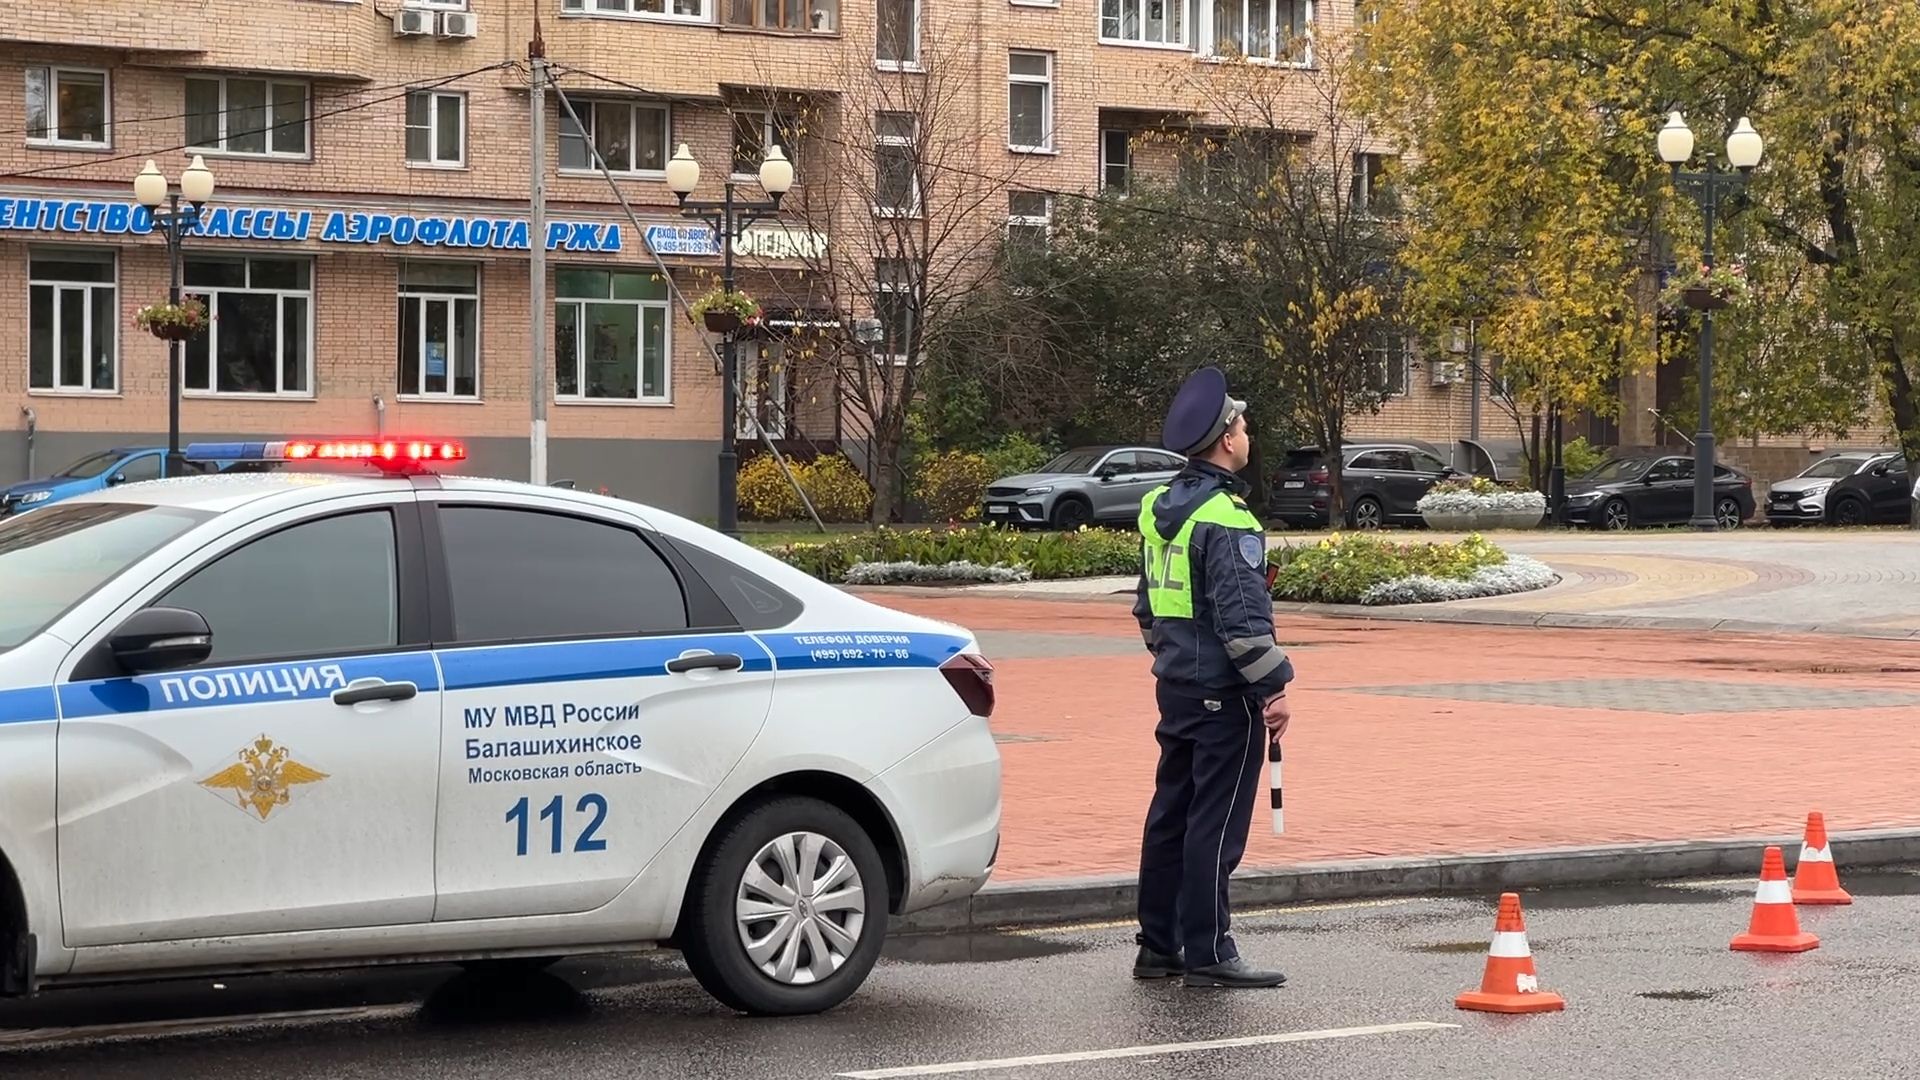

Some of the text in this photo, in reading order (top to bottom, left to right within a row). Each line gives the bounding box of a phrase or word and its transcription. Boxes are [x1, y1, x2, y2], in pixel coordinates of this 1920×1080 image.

[321, 210, 530, 249] АЭРОФЛОТА
[545, 220, 622, 251] РЖД
[657, 227, 676, 240] ВХОД
[794, 634, 910, 645] ТЕЛЕФОН ДОВЕРИЯ
[810, 649, 840, 661] (495)
[842, 648, 864, 659] 692
[872, 648, 886, 658] 70
[160, 664, 347, 703] ПОЛИЦИЯ
[464, 703, 640, 729] МУ МВД России
[466, 733, 642, 759] Балашихинское
[468, 760, 642, 784] Московская область
[505, 793, 608, 856] 112
